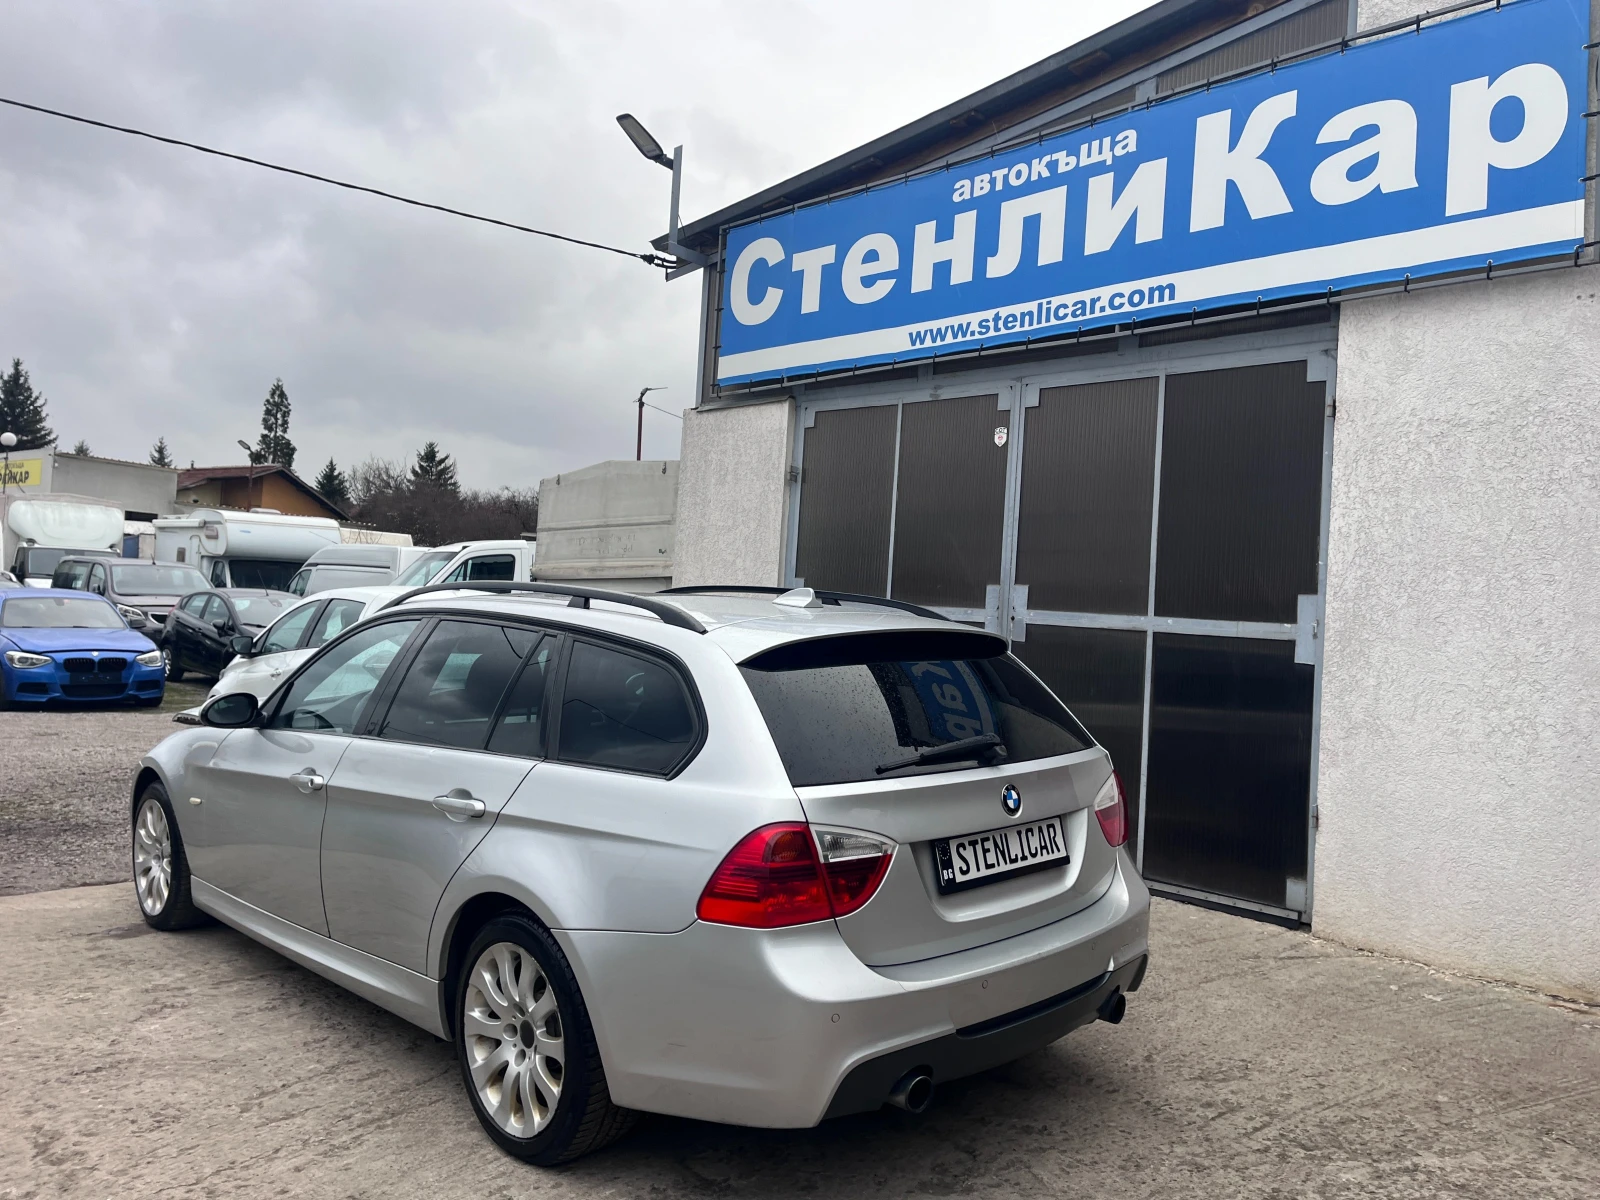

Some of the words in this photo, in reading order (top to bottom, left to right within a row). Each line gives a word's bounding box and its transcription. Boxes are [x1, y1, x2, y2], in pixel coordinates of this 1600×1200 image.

[729, 62, 1569, 326] СтенлиКар
[952, 128, 1138, 203] автокъща
[908, 282, 1176, 347] www.stenlicar.com
[942, 868, 954, 880] BG
[955, 822, 1061, 876] STENLICAR
